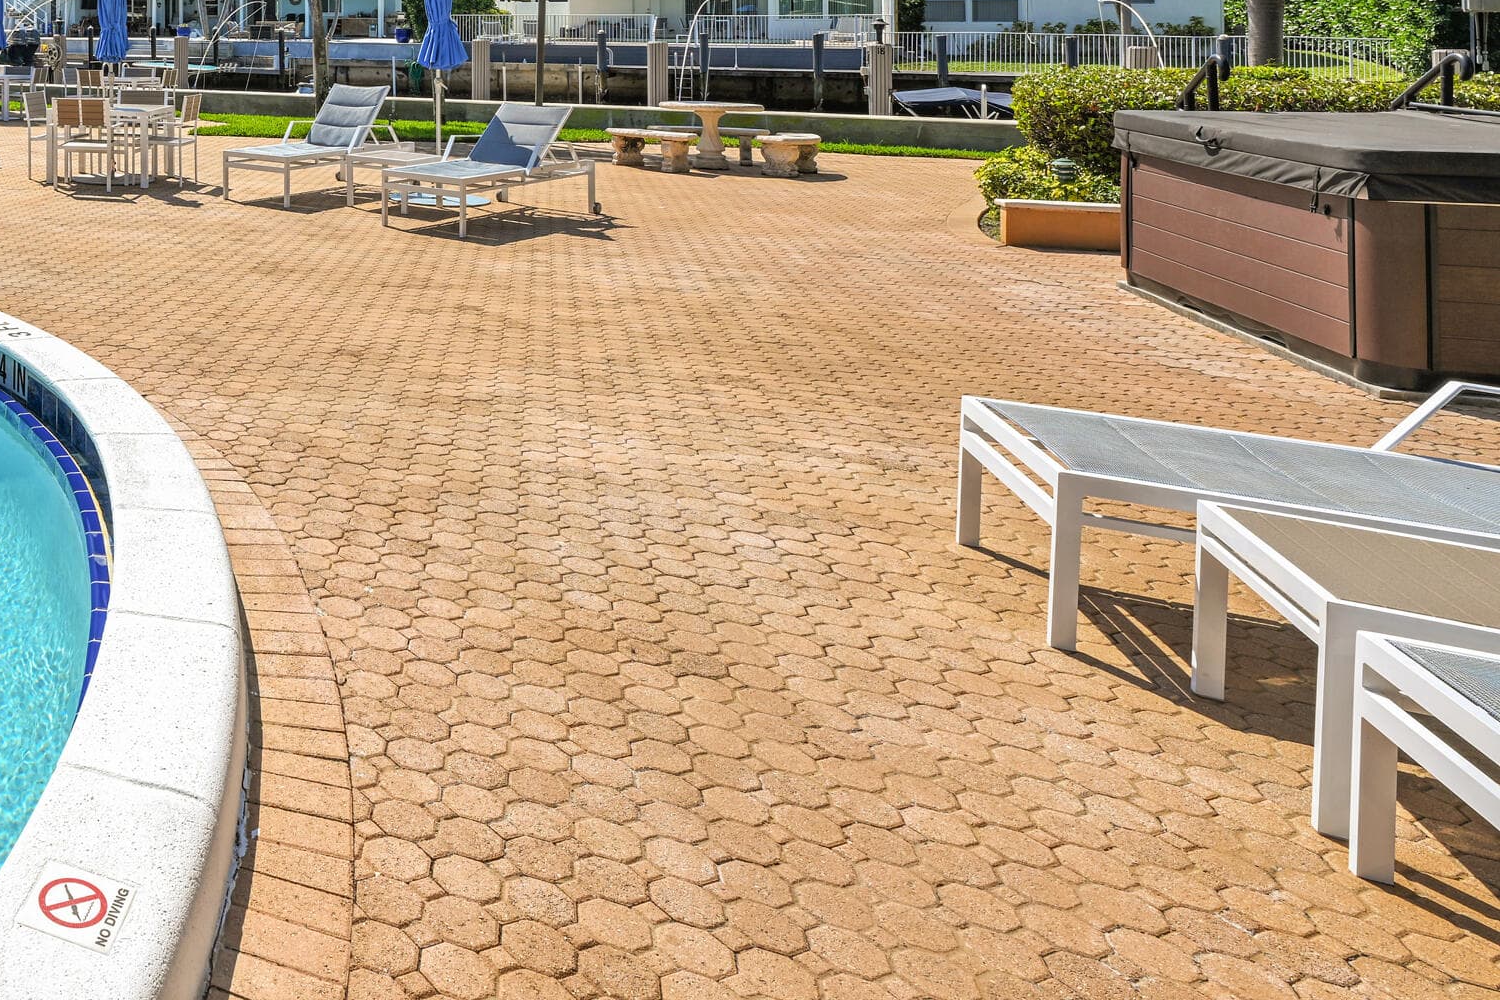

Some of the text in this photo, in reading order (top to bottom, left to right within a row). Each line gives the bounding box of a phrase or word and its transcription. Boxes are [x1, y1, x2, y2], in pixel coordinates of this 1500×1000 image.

[0, 354, 7, 385] 4
[12, 360, 27, 397] IN
[95, 887, 130, 947] NO DIVING
